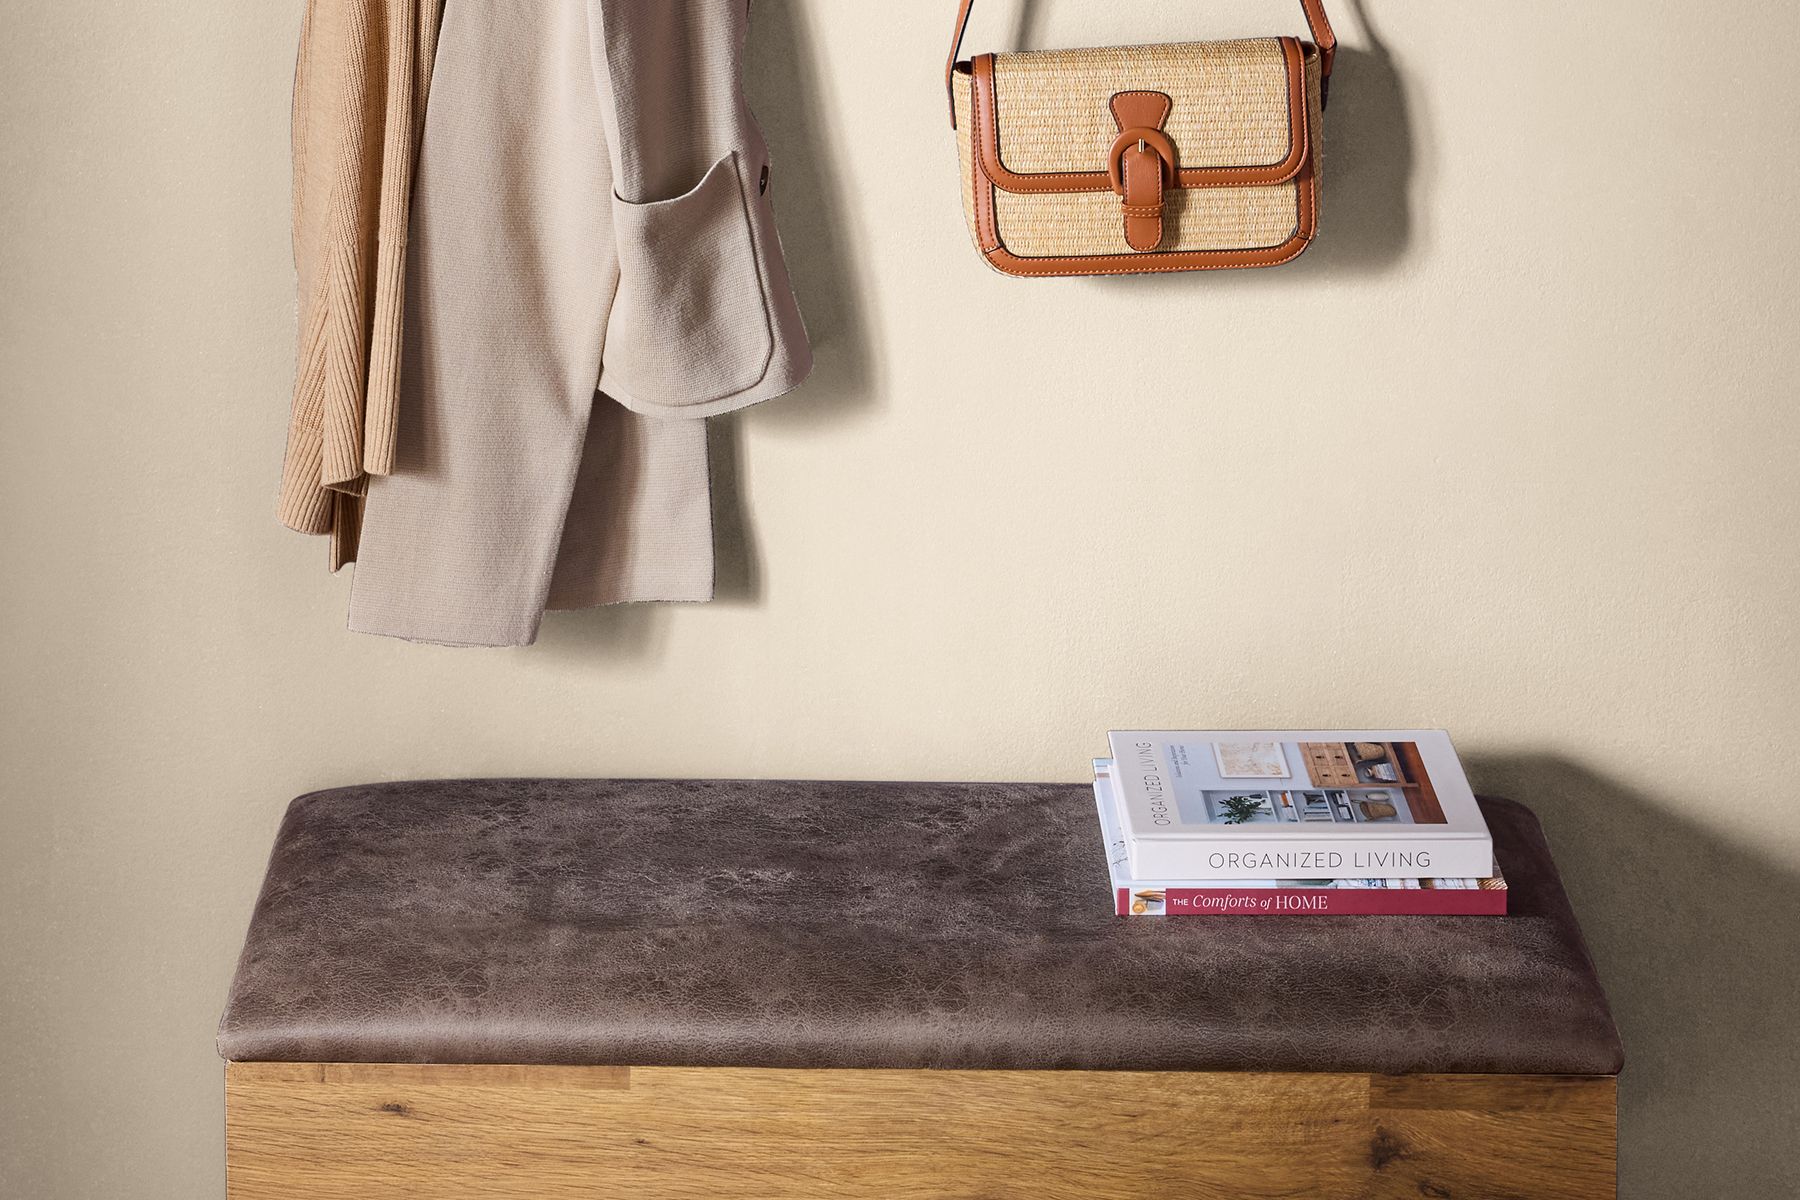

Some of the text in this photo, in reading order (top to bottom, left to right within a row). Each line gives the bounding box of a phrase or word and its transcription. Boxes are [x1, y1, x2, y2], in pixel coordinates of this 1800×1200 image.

[1136, 742, 1171, 826] ORGANIZED LIVING
[1209, 851, 1431, 869] ORGANIZED LIVING
[1172, 894, 1328, 911] THE Comforts of HOME
